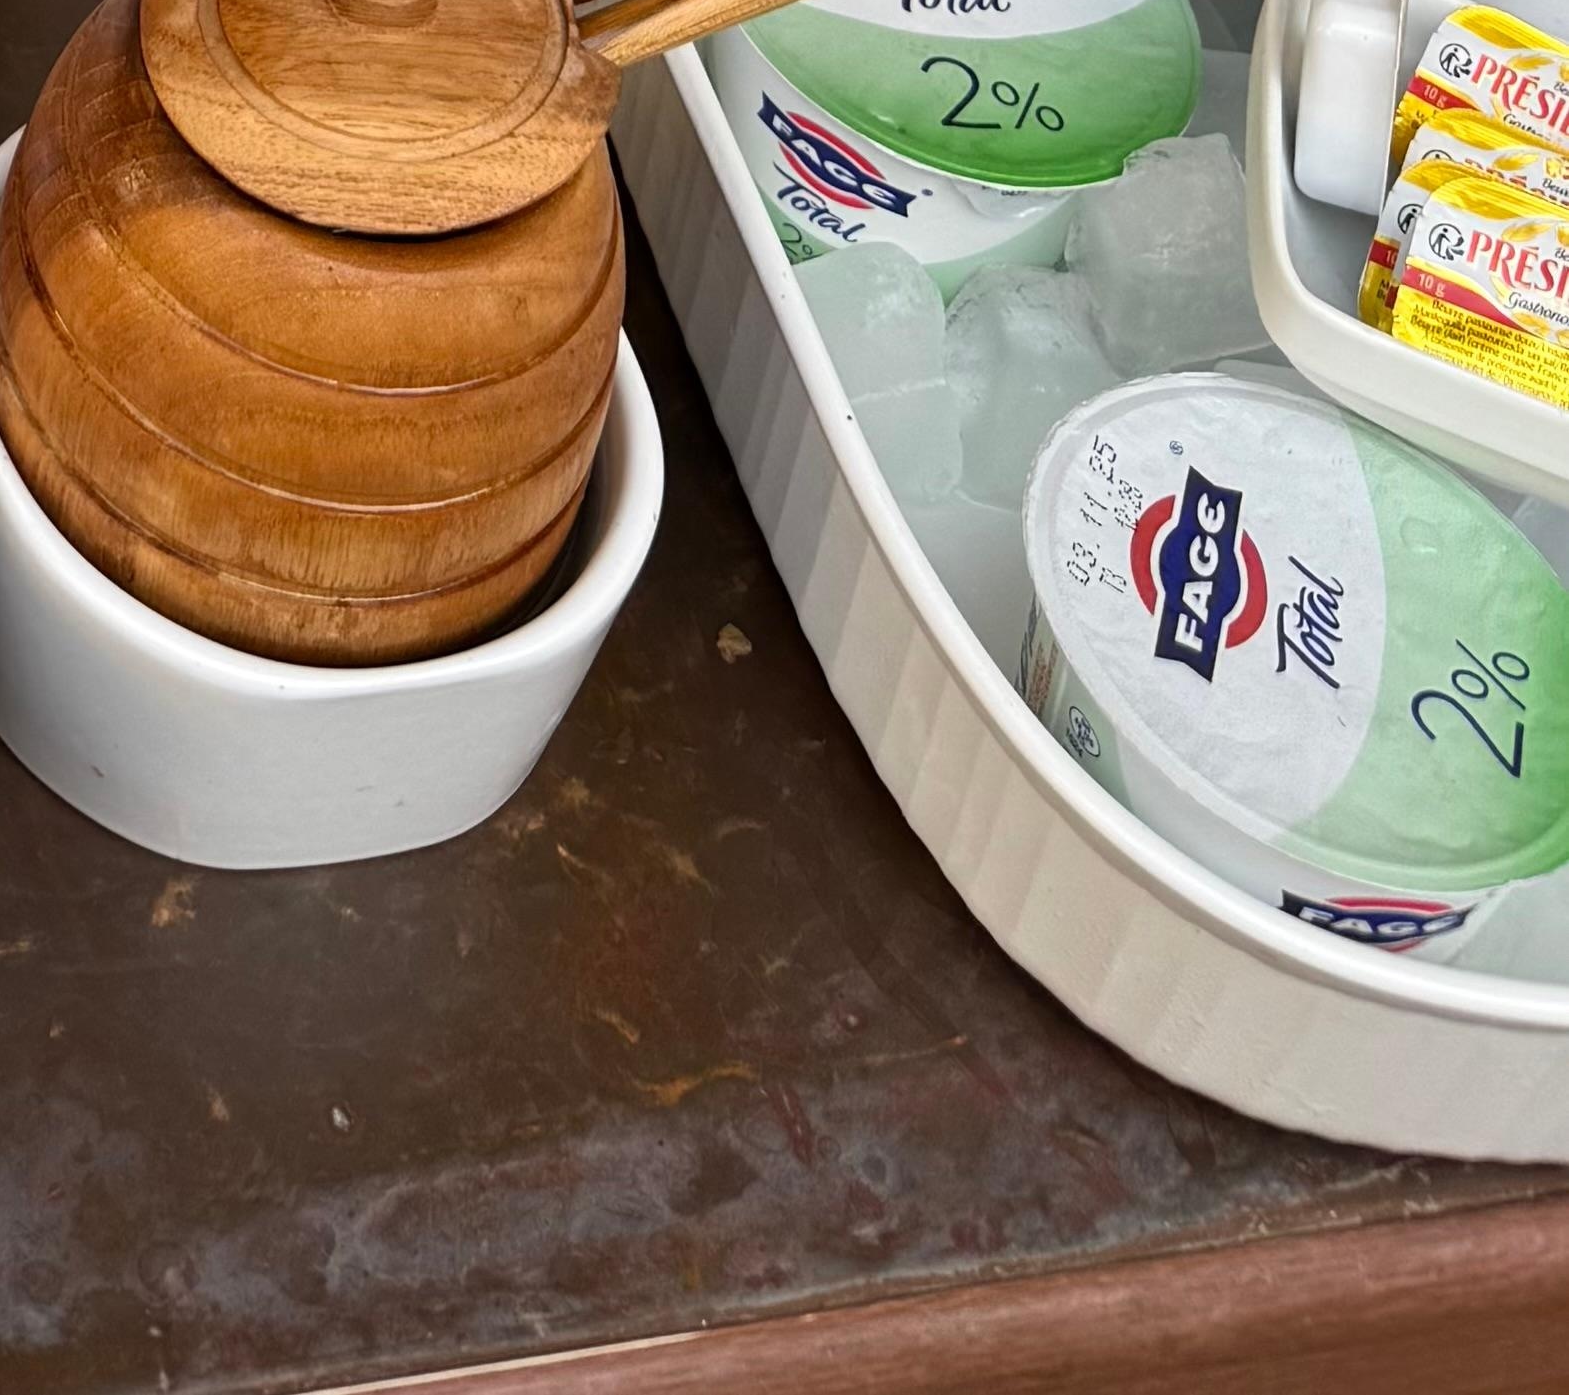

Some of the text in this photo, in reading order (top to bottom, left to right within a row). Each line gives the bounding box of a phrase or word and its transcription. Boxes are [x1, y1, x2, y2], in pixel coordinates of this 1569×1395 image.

[920, 56, 1064, 132] 2%
[1423, 84, 1449, 109] 10 g
[772, 113, 897, 208] FAGE
[772, 161, 866, 243] Total
[1418, 273, 1447, 298] 10 g
[1066, 434, 1117, 586] 03.11.25
[1174, 492, 1226, 652] FAGE
[1275, 555, 1345, 690] Total
[1411, 639, 1530, 779] 2%
[1298, 906, 1462, 934] FAGE
